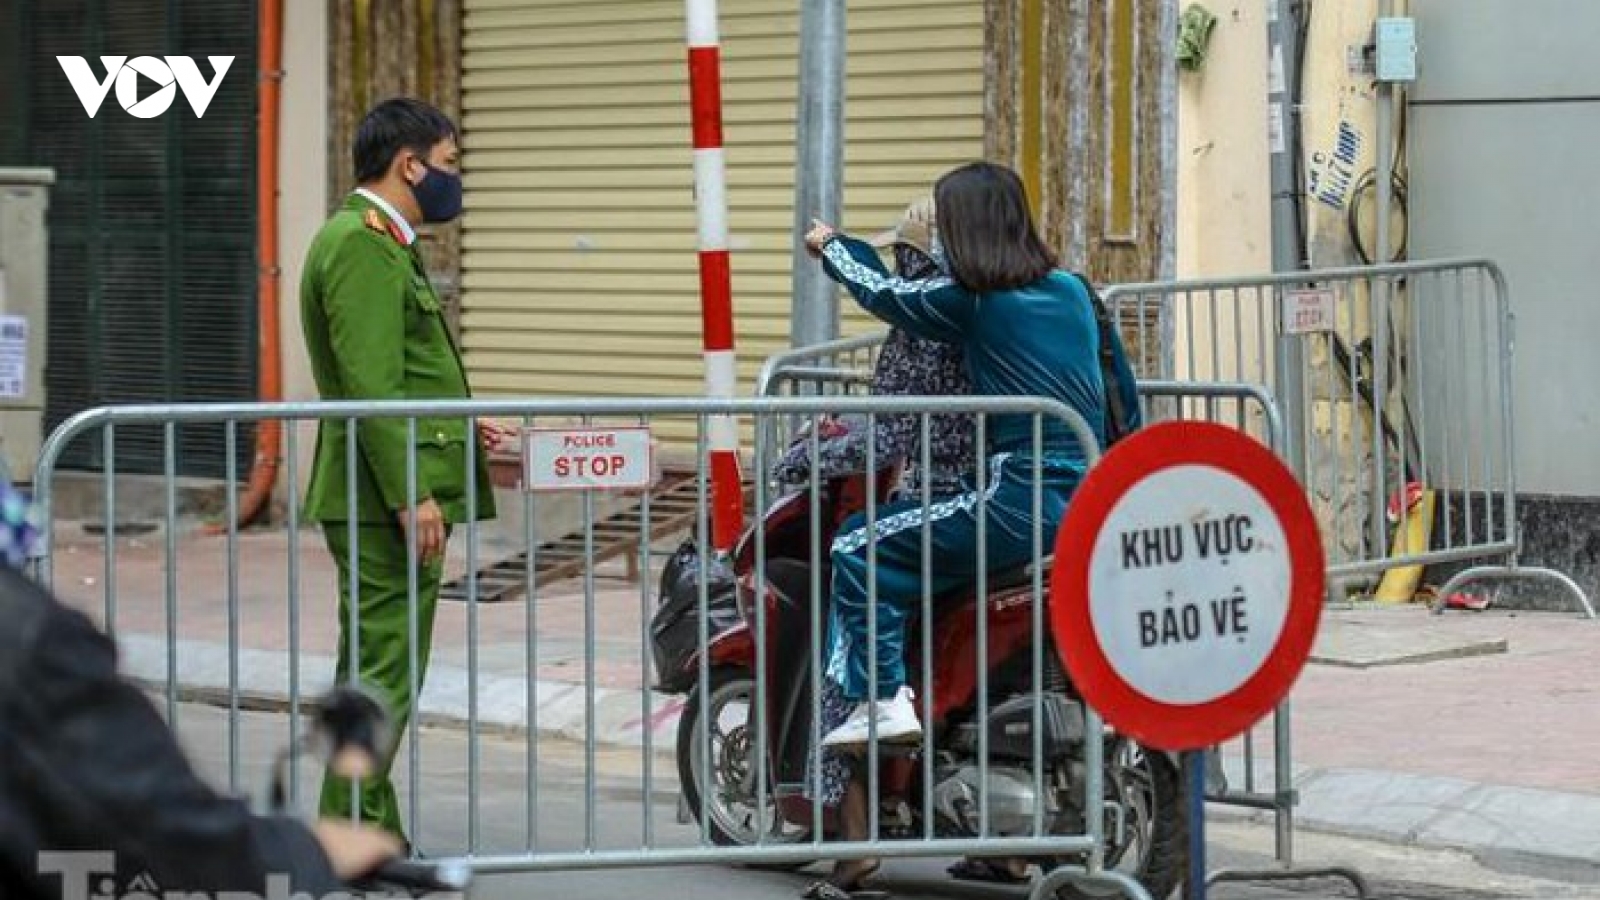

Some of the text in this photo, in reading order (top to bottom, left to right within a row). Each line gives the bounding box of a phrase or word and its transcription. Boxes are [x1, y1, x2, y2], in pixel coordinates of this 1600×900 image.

[564, 433, 615, 447] POLICE
[554, 456, 625, 475] STOP
[1121, 514, 1253, 569] KHU VỰC
[1139, 585, 1248, 648] BẢO VỆ
